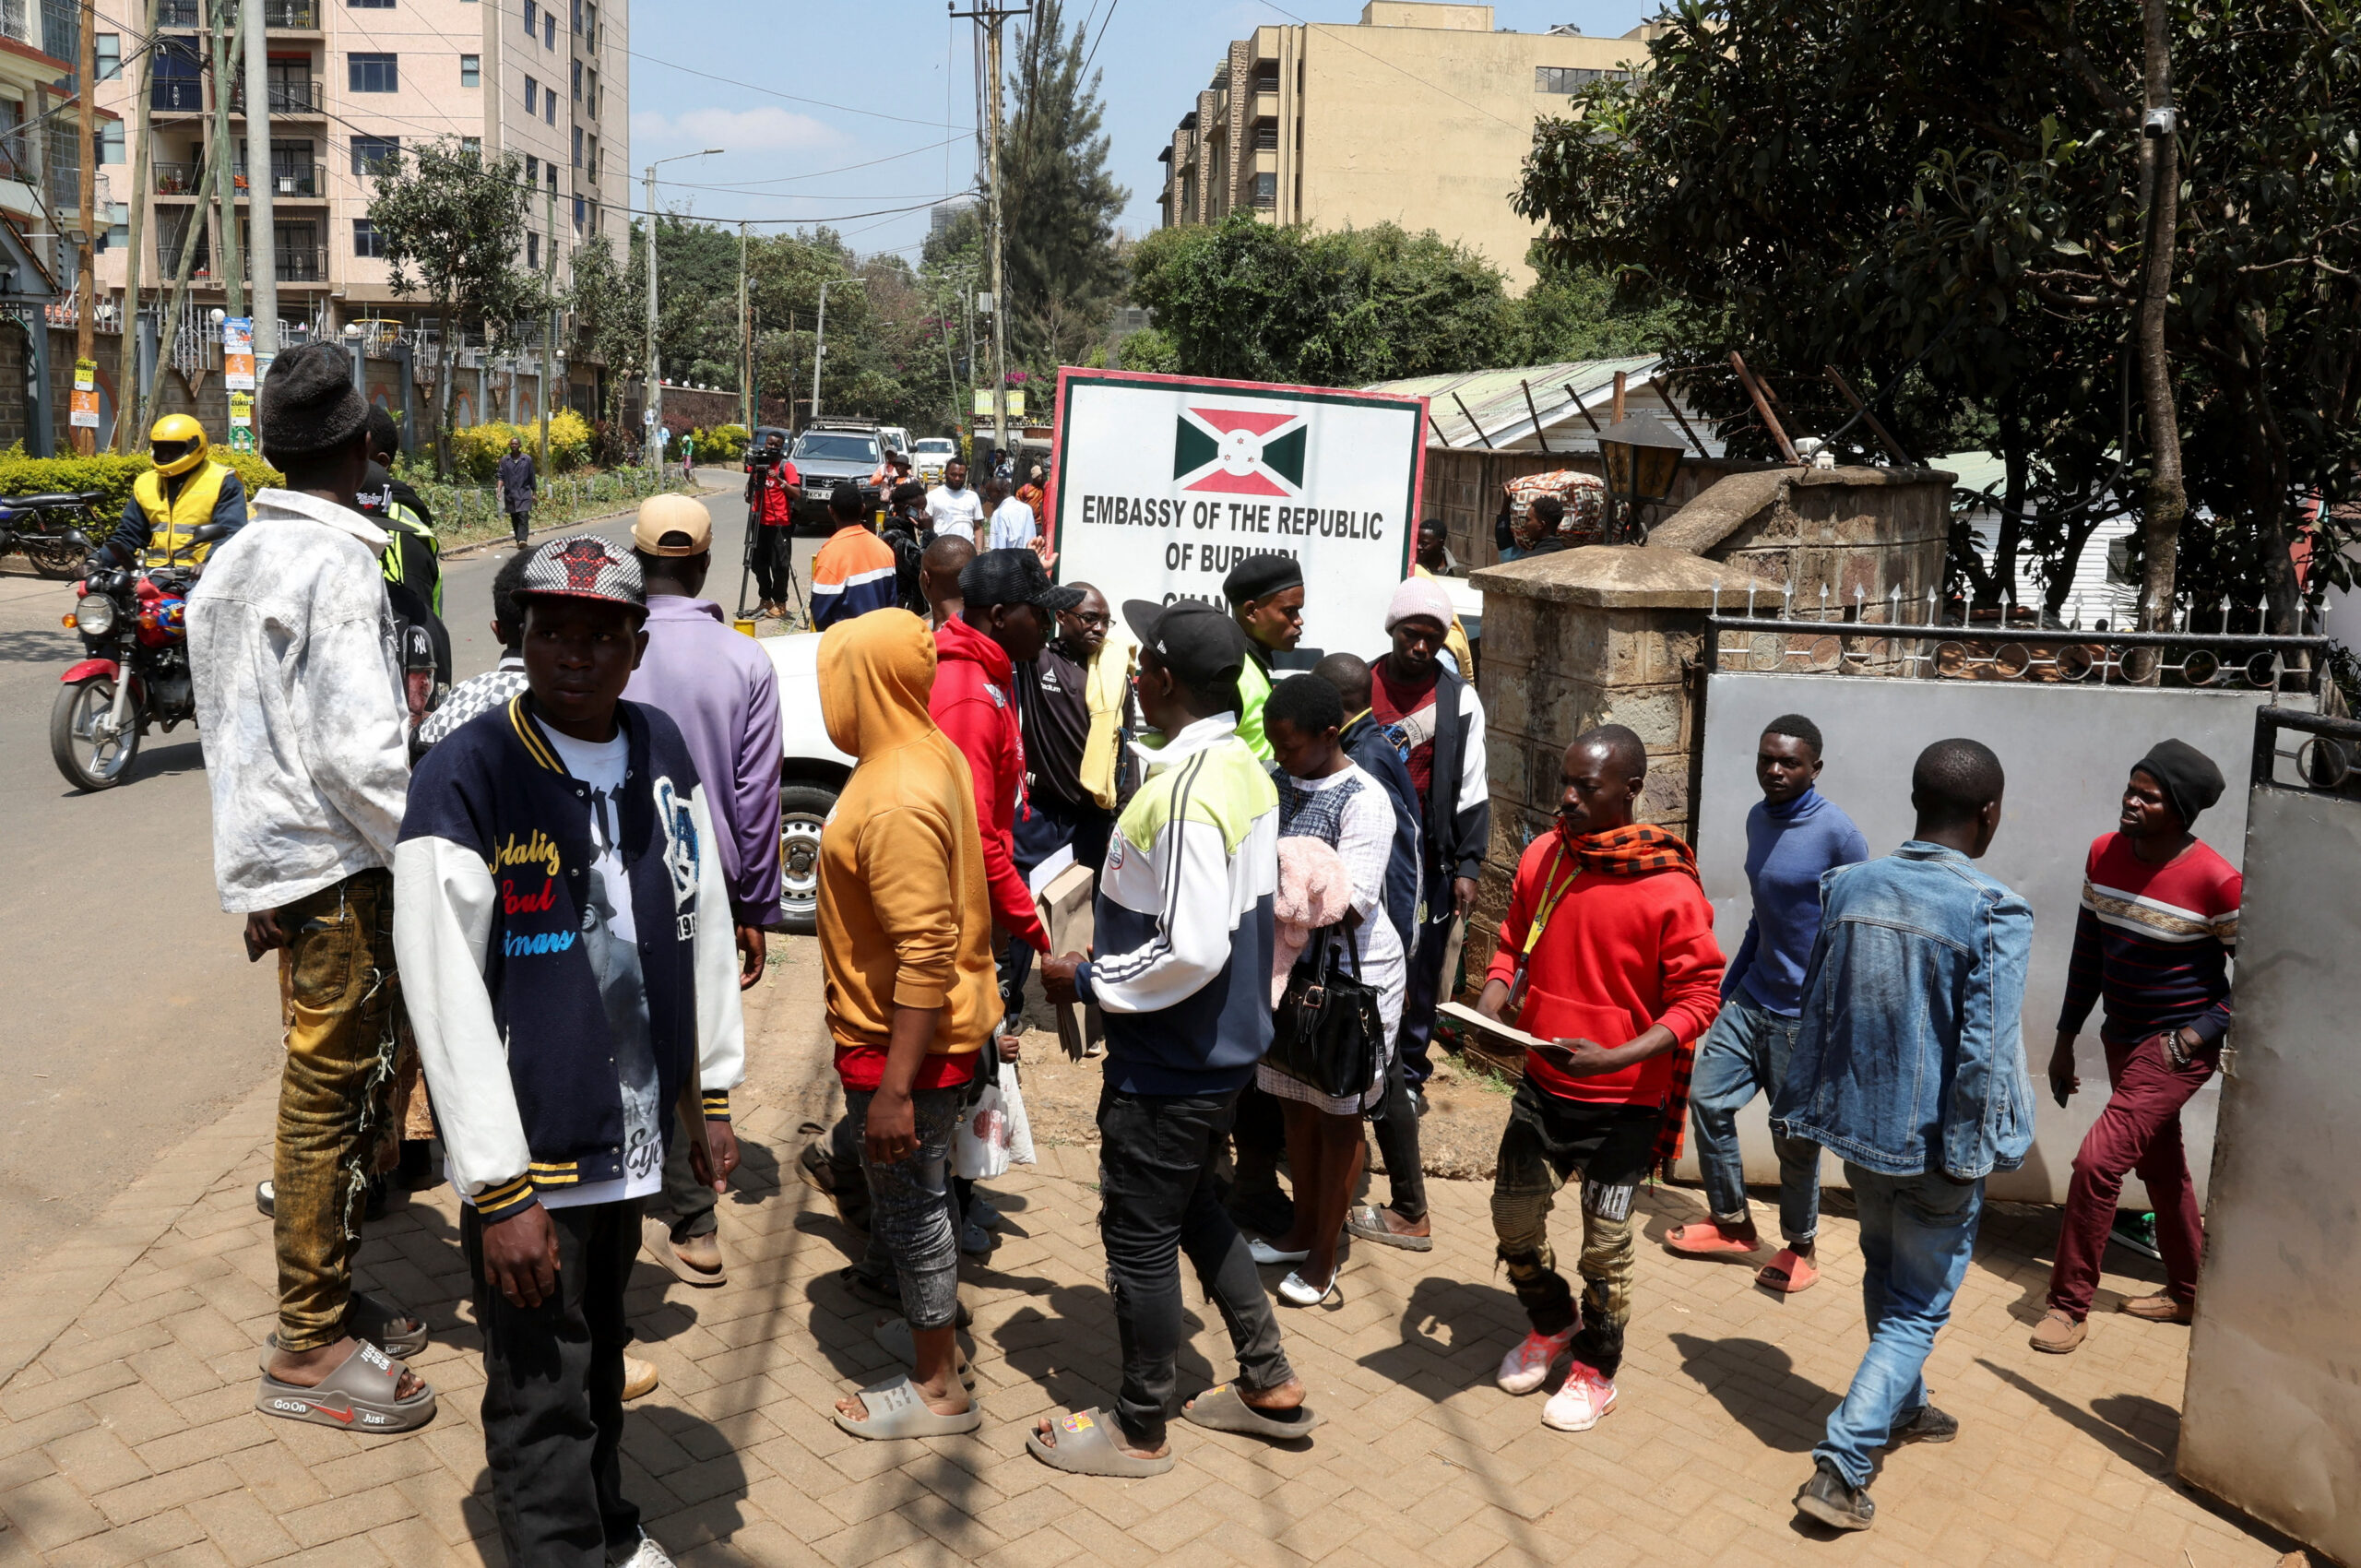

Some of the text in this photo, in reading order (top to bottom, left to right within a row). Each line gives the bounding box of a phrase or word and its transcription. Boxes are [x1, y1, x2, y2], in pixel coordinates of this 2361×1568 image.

[1082, 494, 1384, 541] EMBASSY OF THE REPUBLIC
[1165, 541, 1193, 571] OF
[274, 1398, 306, 1413] Go On
[362, 1413, 386, 1424] Just
